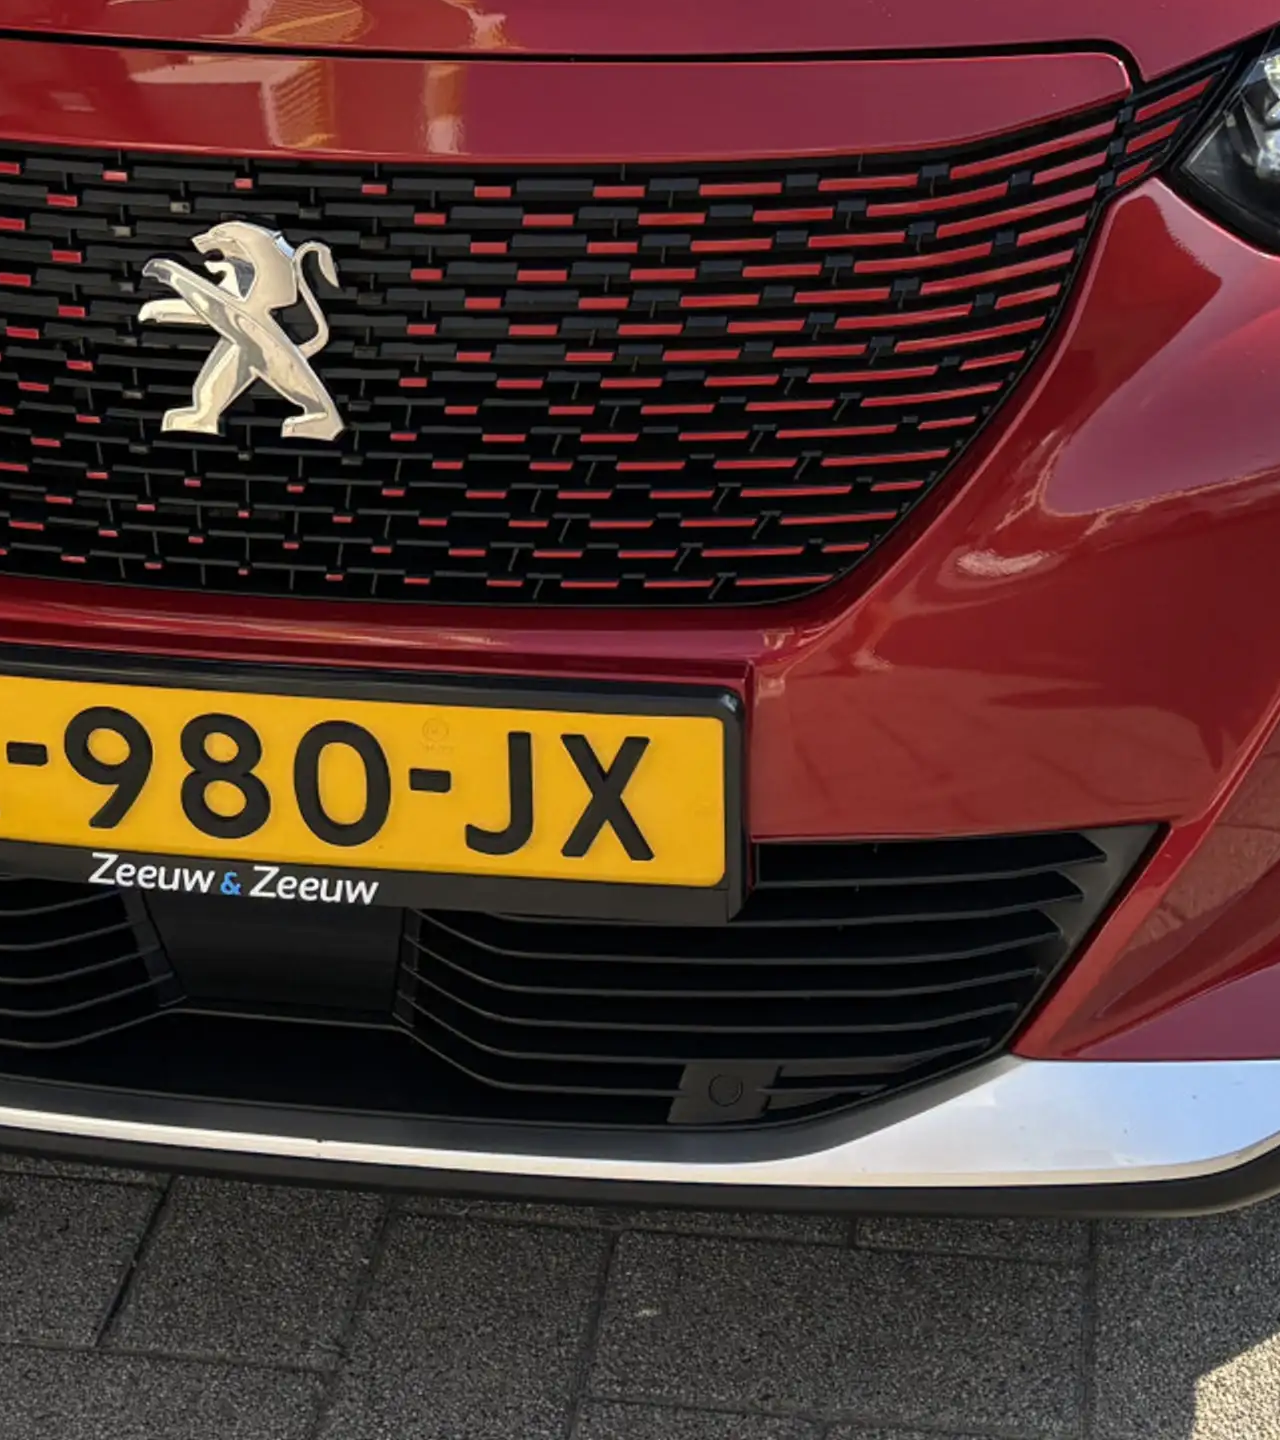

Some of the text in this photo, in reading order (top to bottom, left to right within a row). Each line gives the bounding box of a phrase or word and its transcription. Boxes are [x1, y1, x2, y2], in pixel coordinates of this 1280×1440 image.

[87, 851, 380, 905] Zeeuw & Zeeuw
